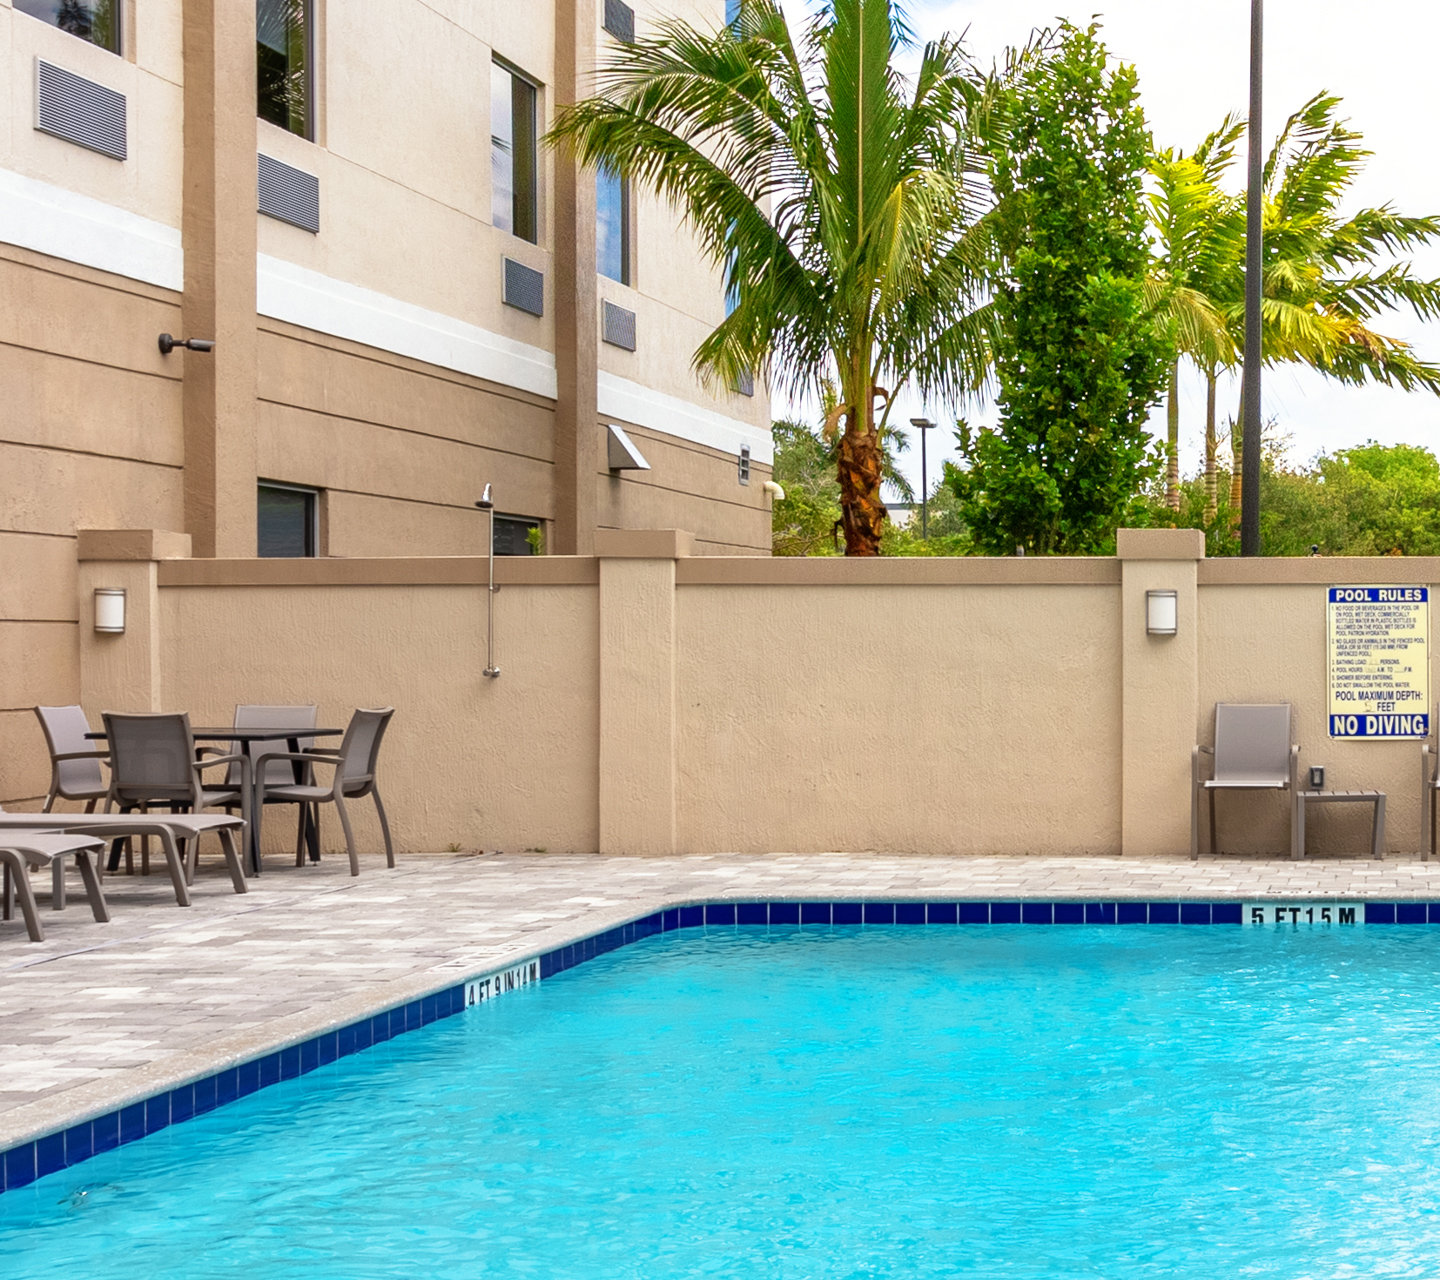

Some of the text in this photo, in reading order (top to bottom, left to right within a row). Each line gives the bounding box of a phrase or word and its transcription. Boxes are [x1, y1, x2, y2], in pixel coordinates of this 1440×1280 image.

[1336, 589, 1422, 601] POOL RULES
[1336, 691, 1423, 700] POOL MAXIMUM DEPTH:
[1377, 702, 1395, 711] FEET
[1334, 715, 1424, 735] NO DIVING
[1252, 908, 1264, 924] 5
